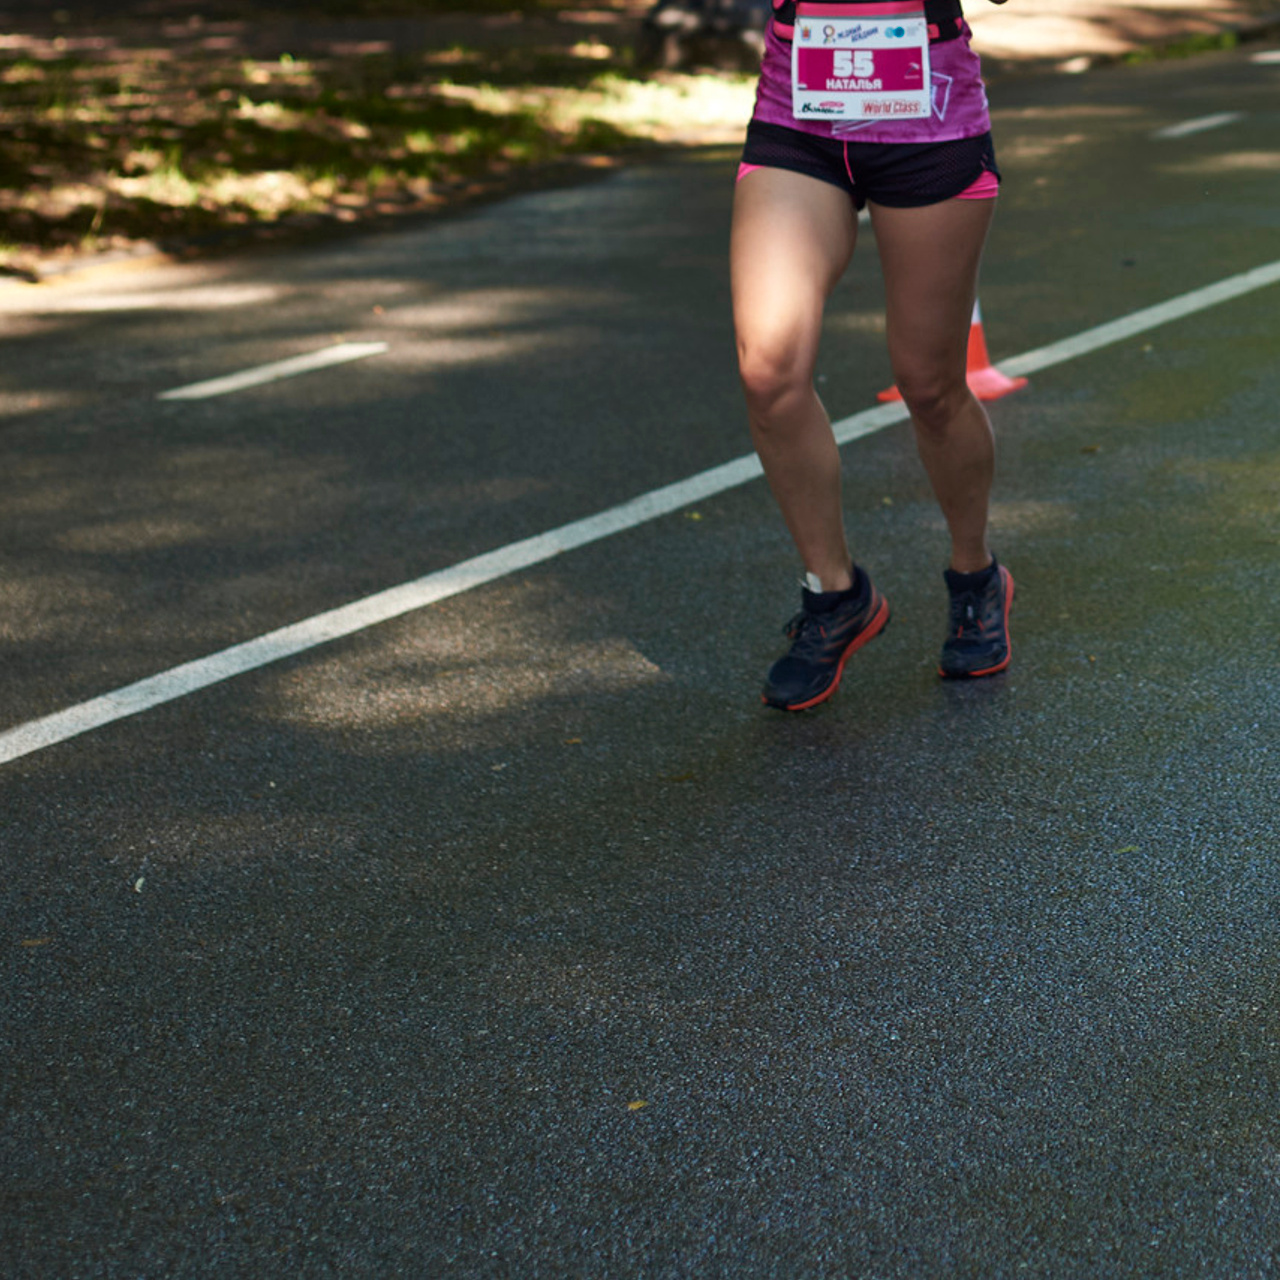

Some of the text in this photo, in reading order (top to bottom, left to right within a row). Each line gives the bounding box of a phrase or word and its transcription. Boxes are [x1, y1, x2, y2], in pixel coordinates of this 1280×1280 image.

[832, 49, 875, 79] 55
[826, 78, 882, 90] НАТАЛЬЯ
[864, 102, 919, 114] World Class
